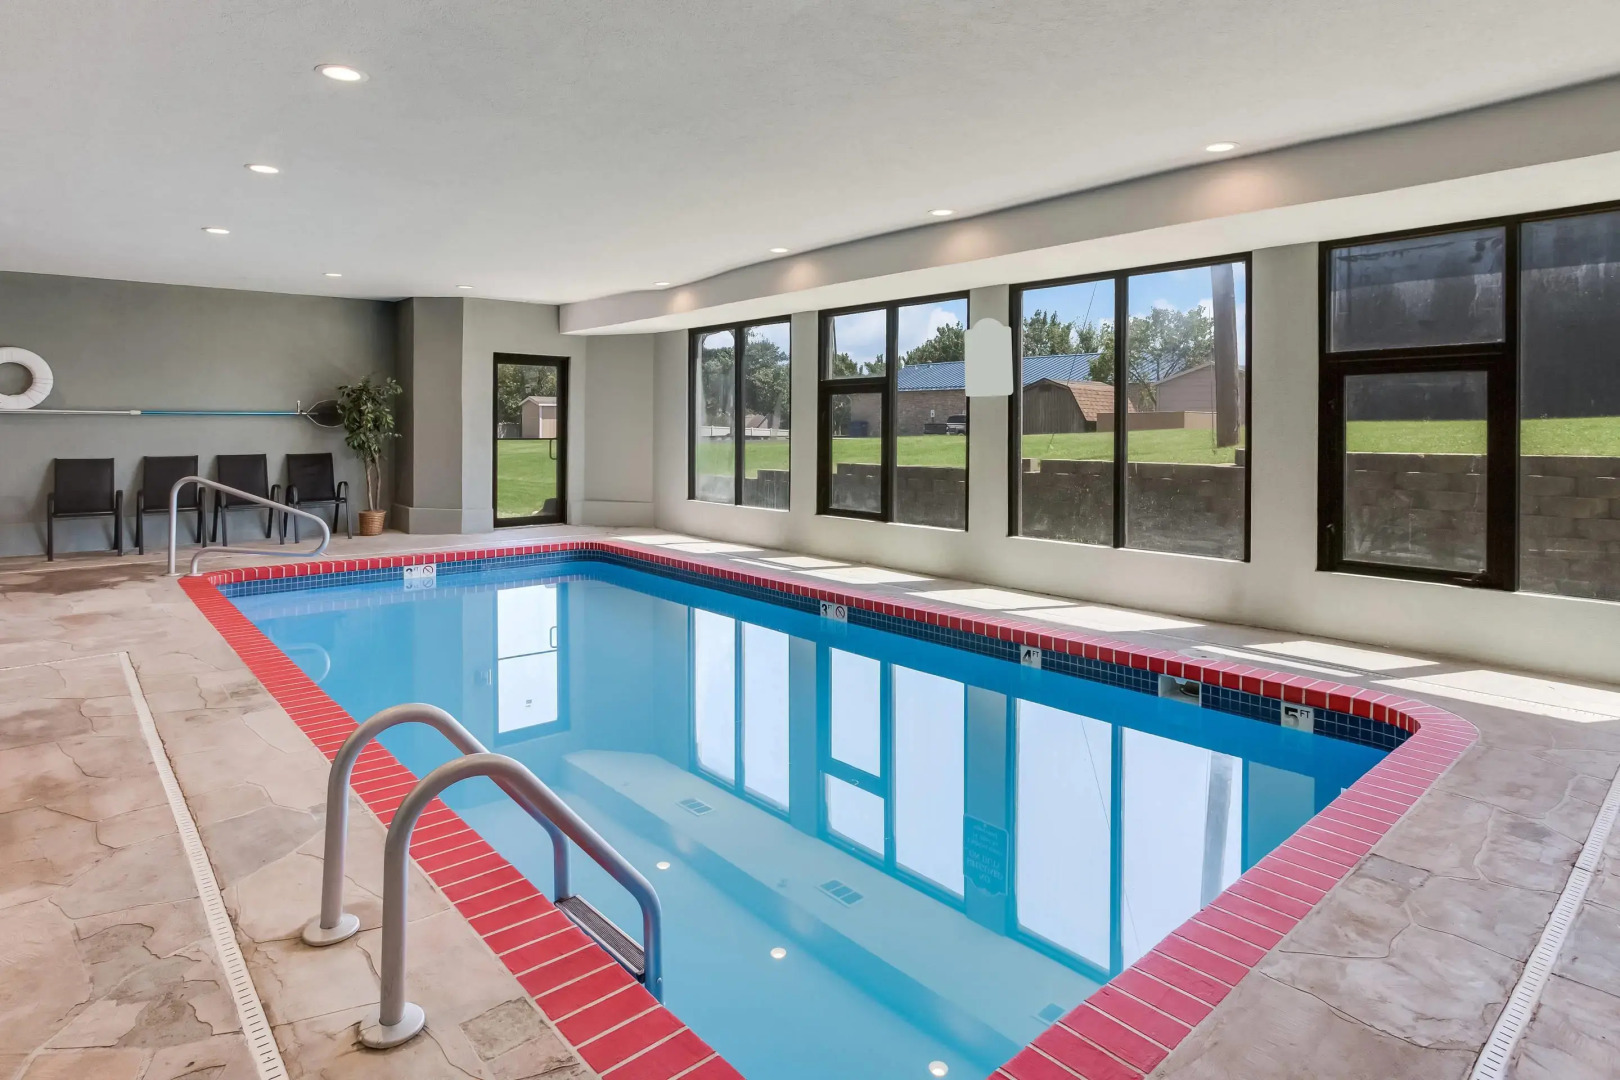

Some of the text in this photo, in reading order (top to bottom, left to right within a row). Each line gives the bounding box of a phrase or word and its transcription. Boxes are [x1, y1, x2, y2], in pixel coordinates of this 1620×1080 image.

[821, 603, 828, 616] 3
[1022, 649, 1040, 665] 4 FT
[1284, 706, 1311, 728] 5 FT
